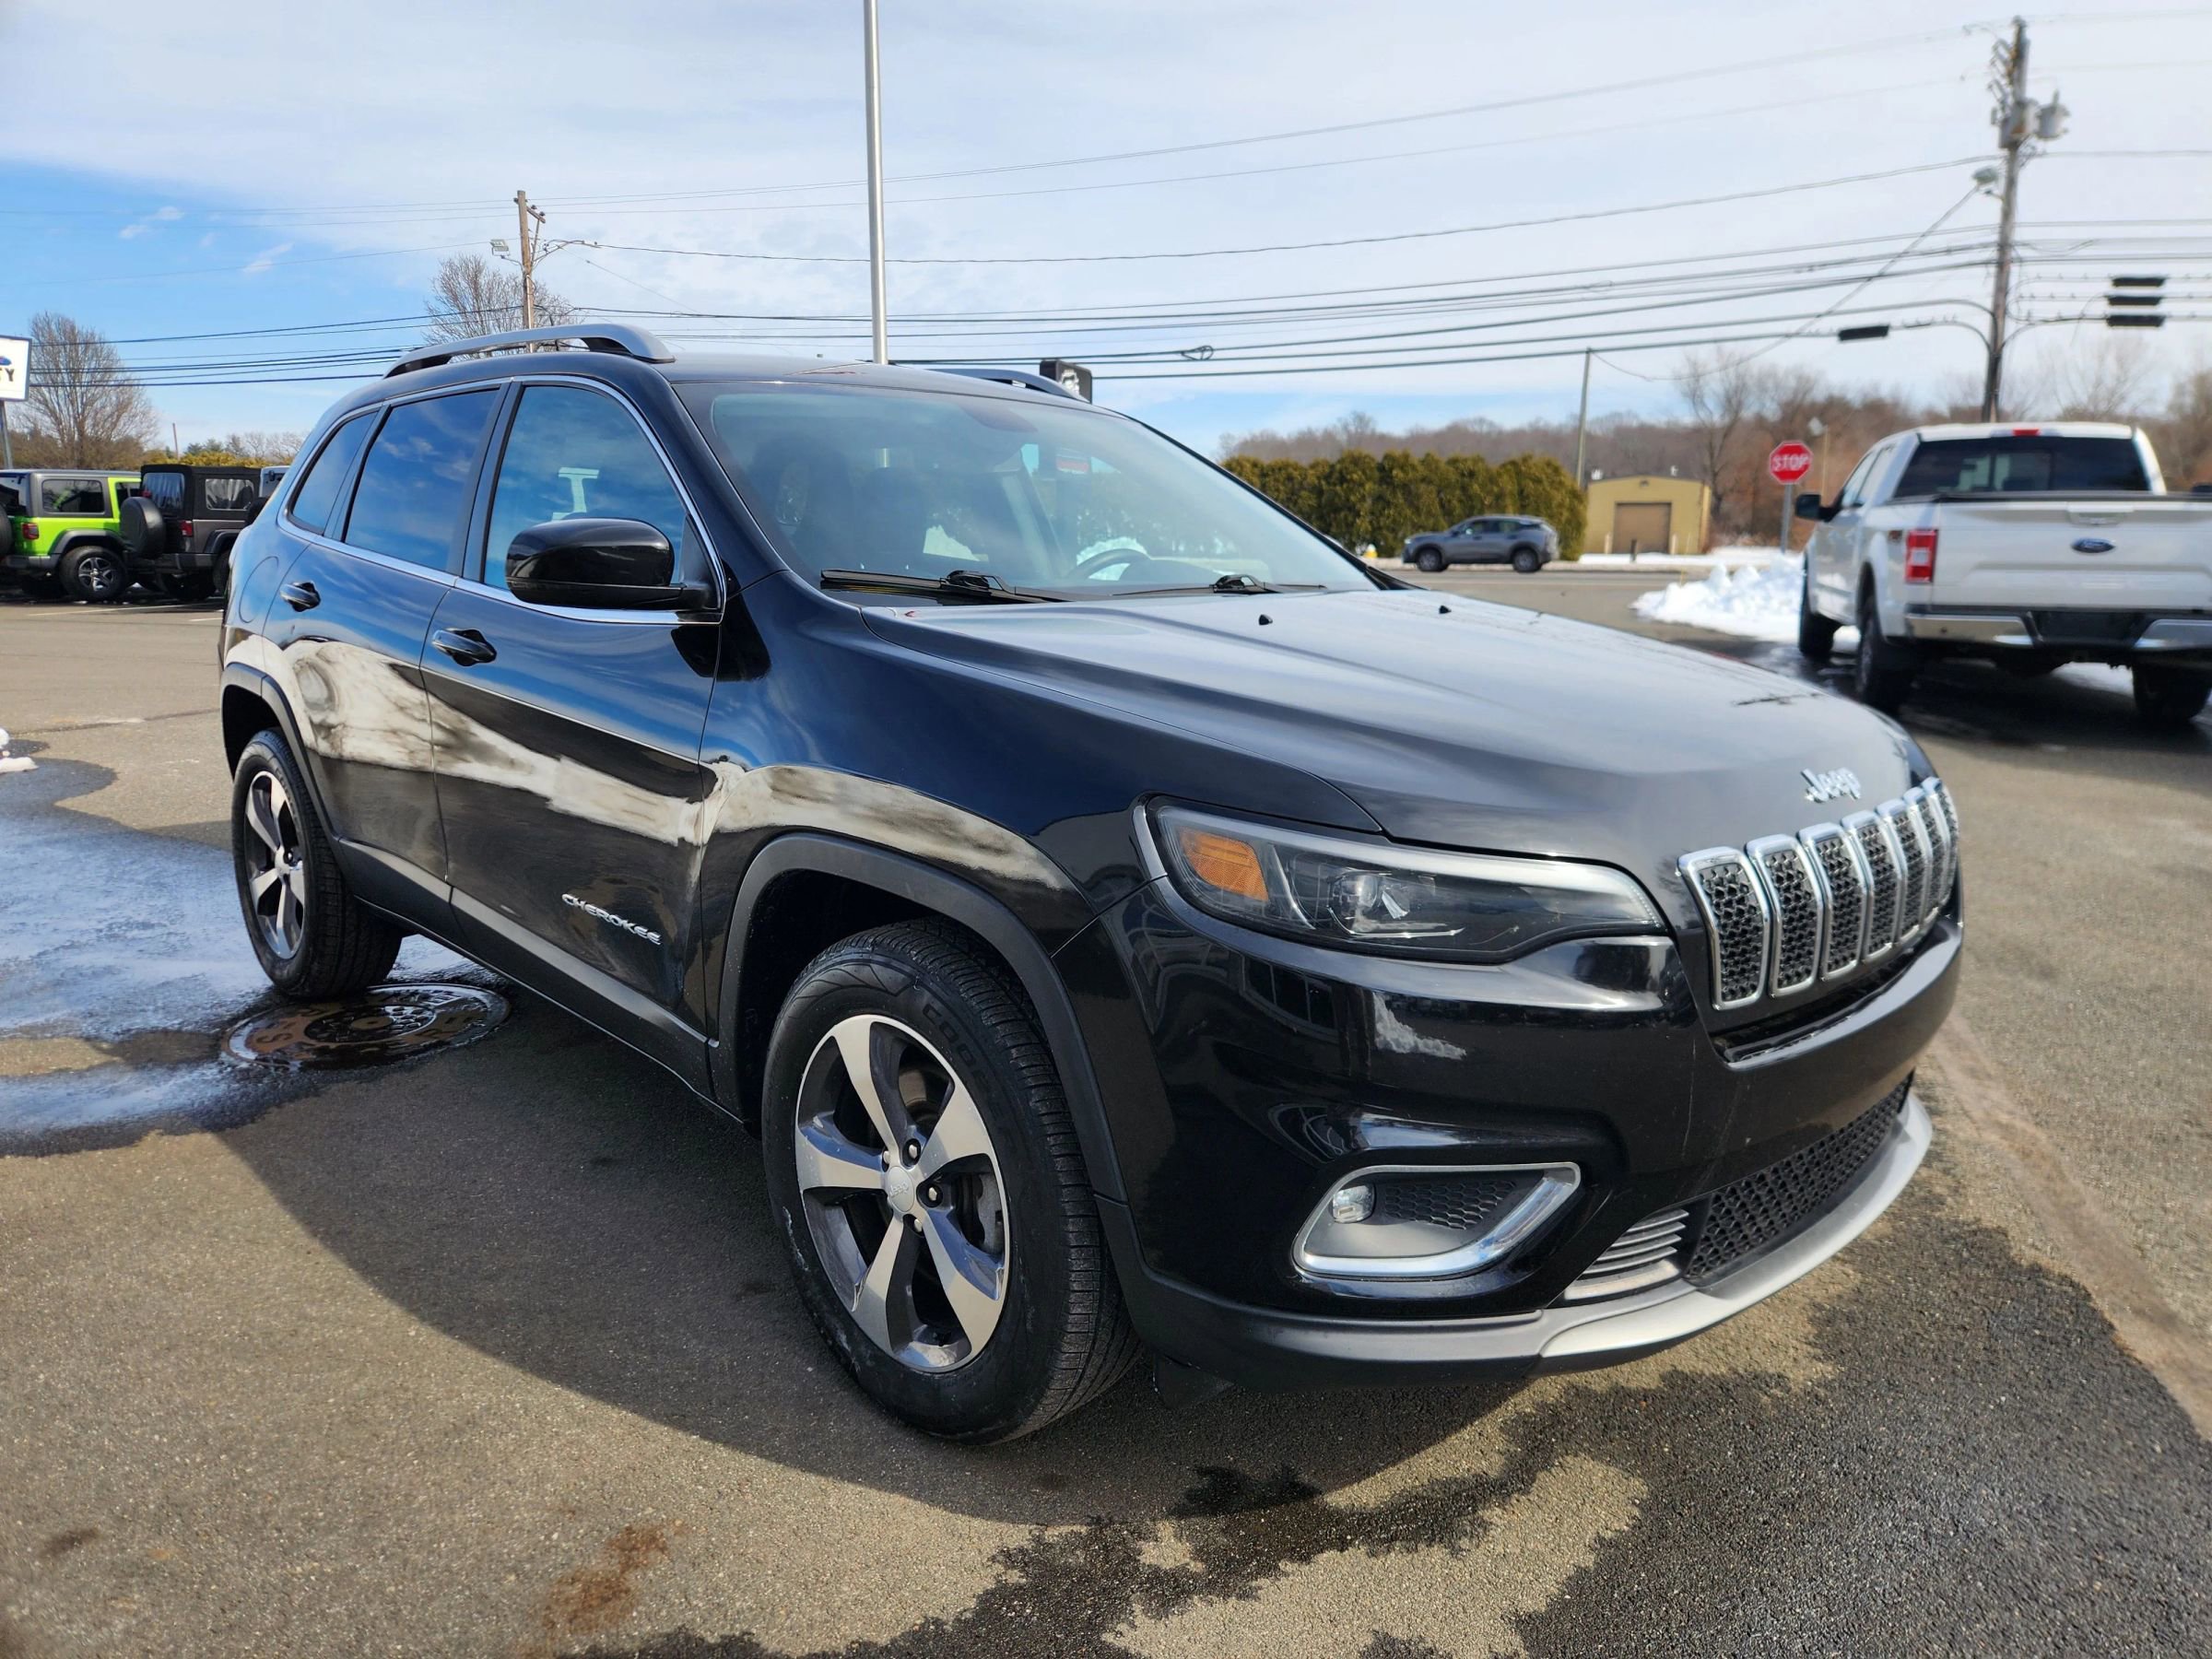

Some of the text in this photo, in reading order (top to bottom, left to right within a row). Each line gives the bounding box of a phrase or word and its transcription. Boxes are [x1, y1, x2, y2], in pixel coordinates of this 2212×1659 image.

[1772, 453, 1809, 471] STOP
[1801, 768, 1861, 803] Jeep
[561, 893, 662, 946] CHEROKEE
